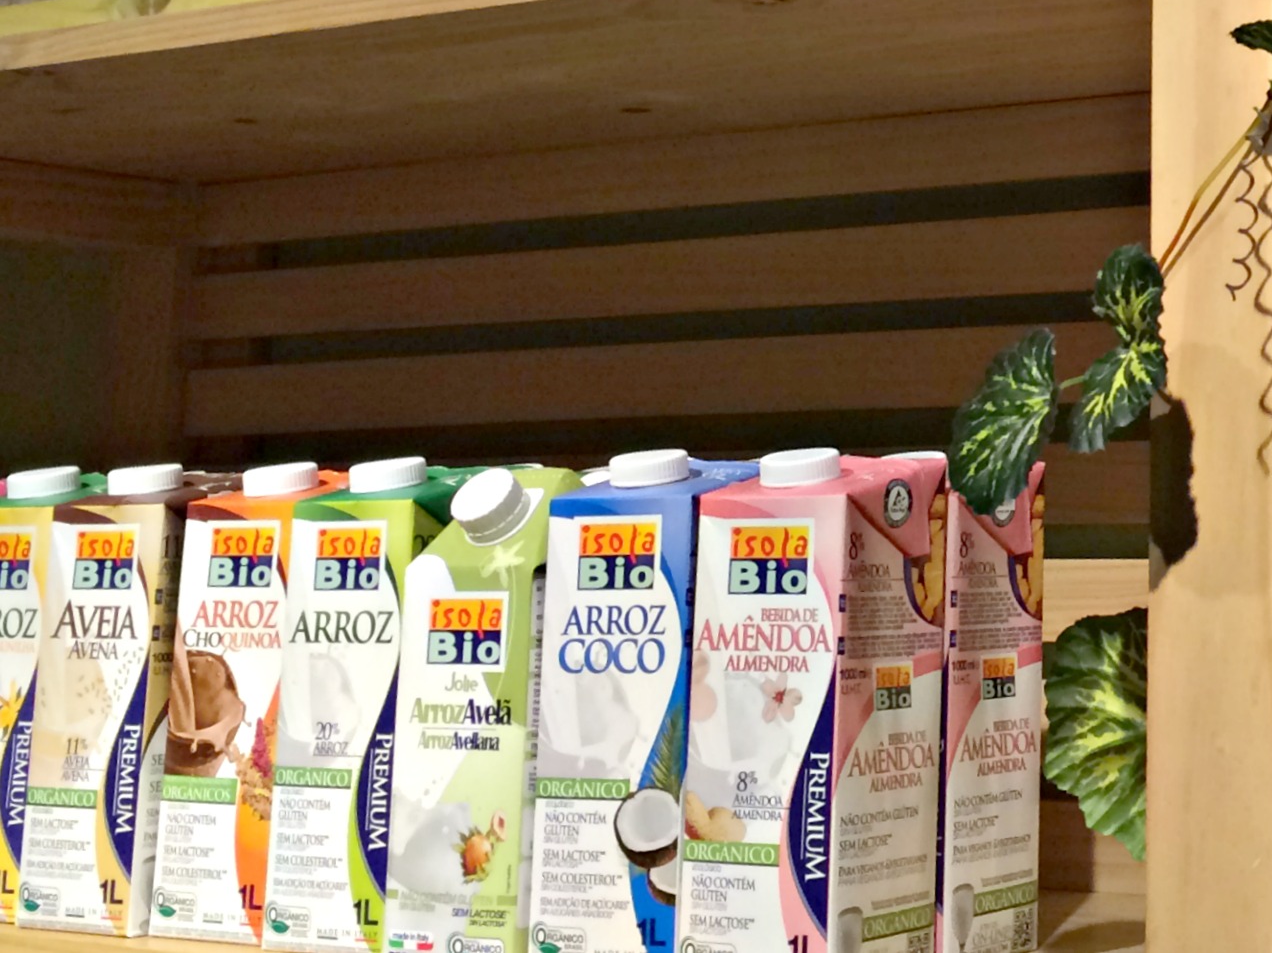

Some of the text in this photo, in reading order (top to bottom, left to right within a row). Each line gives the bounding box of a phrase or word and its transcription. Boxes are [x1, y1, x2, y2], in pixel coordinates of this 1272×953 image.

[74, 560, 132, 588] Bio
[208, 557, 271, 587] Bio
[315, 559, 379, 589] Bio
[579, 557, 654, 589] Bio
[729, 560, 806, 594] Bio
[51, 600, 137, 639] AVEIA
[191, 600, 279, 628] ARROZ
[561, 605, 667, 636] ARROZ
[761, 608, 819, 622] BEBIDA DE
[289, 610, 394, 644] ARROZ
[695, 615, 832, 653] AMÊNDOA
[67, 641, 118, 660] AVENA
[183, 629, 281, 650] CHOQUINOA
[428, 632, 500, 663] Bio
[558, 638, 665, 674] COCO
[724, 655, 809, 673] ALMENDRA
[445, 675, 478, 692] Jolie
[982, 679, 1016, 699] Bio
[876, 687, 912, 710] Bio
[410, 698, 512, 726] ArrozAvelã
[313, 742, 349, 756] ARROZ
[959, 728, 1037, 763] AMÊNDOA
[63, 757, 90, 770] AVEIA
[847, 741, 936, 778] AMÊNDOA
[977, 757, 1027, 777] ALMENDRA
[8, 721, 32, 827] PREMIUM
[60, 770, 90, 782] AVENA
[114, 723, 141, 835] PREMIUM
[275, 767, 348, 787] ORGÂNICO
[869, 772, 923, 794] ALMENDRA
[28, 787, 94, 806] ORGÂNICO
[163, 784, 231, 801] ORGÂNICOS
[367, 732, 393, 852] PREMIUM
[539, 778, 626, 798] ORGÂNICO
[733, 793, 783, 807] AMÊNDOA
[545, 811, 607, 824] NÃO CONTÉM
[732, 808, 782, 821] ALMENDRA
[804, 752, 830, 881] PREMIUM
[543, 849, 561, 861] SEM
[685, 841, 775, 863] ORGÂNICO
[542, 873, 561, 885] SEM
[692, 875, 756, 890] NÃO CONTÉM
[99, 880, 123, 904] 1L
[237, 885, 262, 910] 1L
[974, 883, 1036, 912] ORGÂNICO
[353, 899, 378, 926] 1L
[690, 914, 709, 927] SEM
[864, 907, 932, 939] ORGÂNICO
[636, 918, 666, 946] 1L
